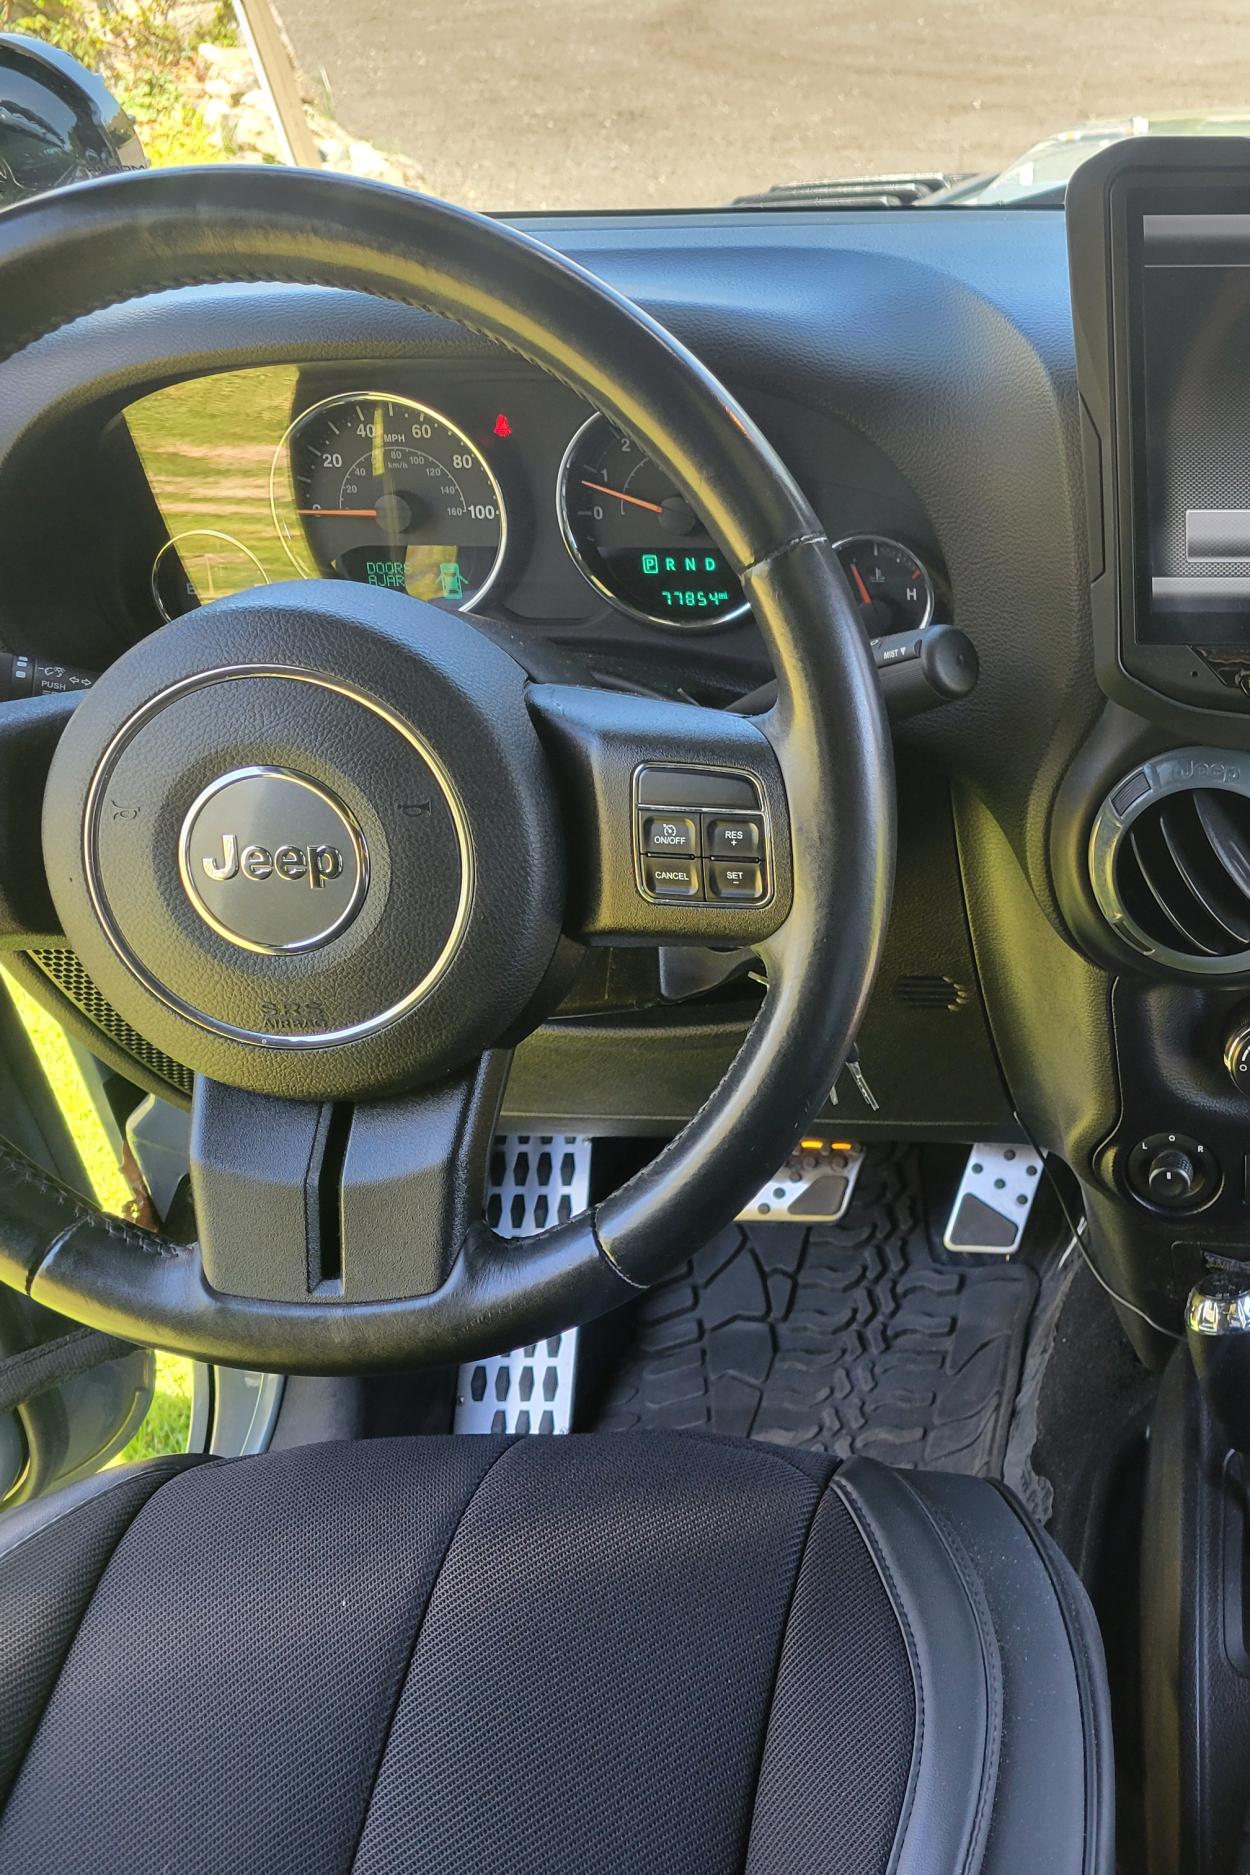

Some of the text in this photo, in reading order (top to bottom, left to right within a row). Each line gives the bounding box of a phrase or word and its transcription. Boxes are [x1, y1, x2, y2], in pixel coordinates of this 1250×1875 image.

[356, 424, 375, 438] 40
[411, 424, 432, 439] 60
[384, 434, 406, 443] MPH
[323, 454, 342, 468] 20
[453, 455, 472, 468] 80
[468, 505, 495, 519] 100
[665, 558, 676, 571] R
[685, 558, 696, 571] N
[705, 558, 716, 571] D
[906, 588, 917, 600] H
[883, 651, 899, 660] MIST
[41, 680, 66, 690] PUSH
[654, 836, 686, 845] ON/OFF
[725, 830, 744, 840] RES
[202, 834, 343, 889] Jeep
[655, 871, 689, 882] CANCEL
[726, 872, 743, 880] SET
